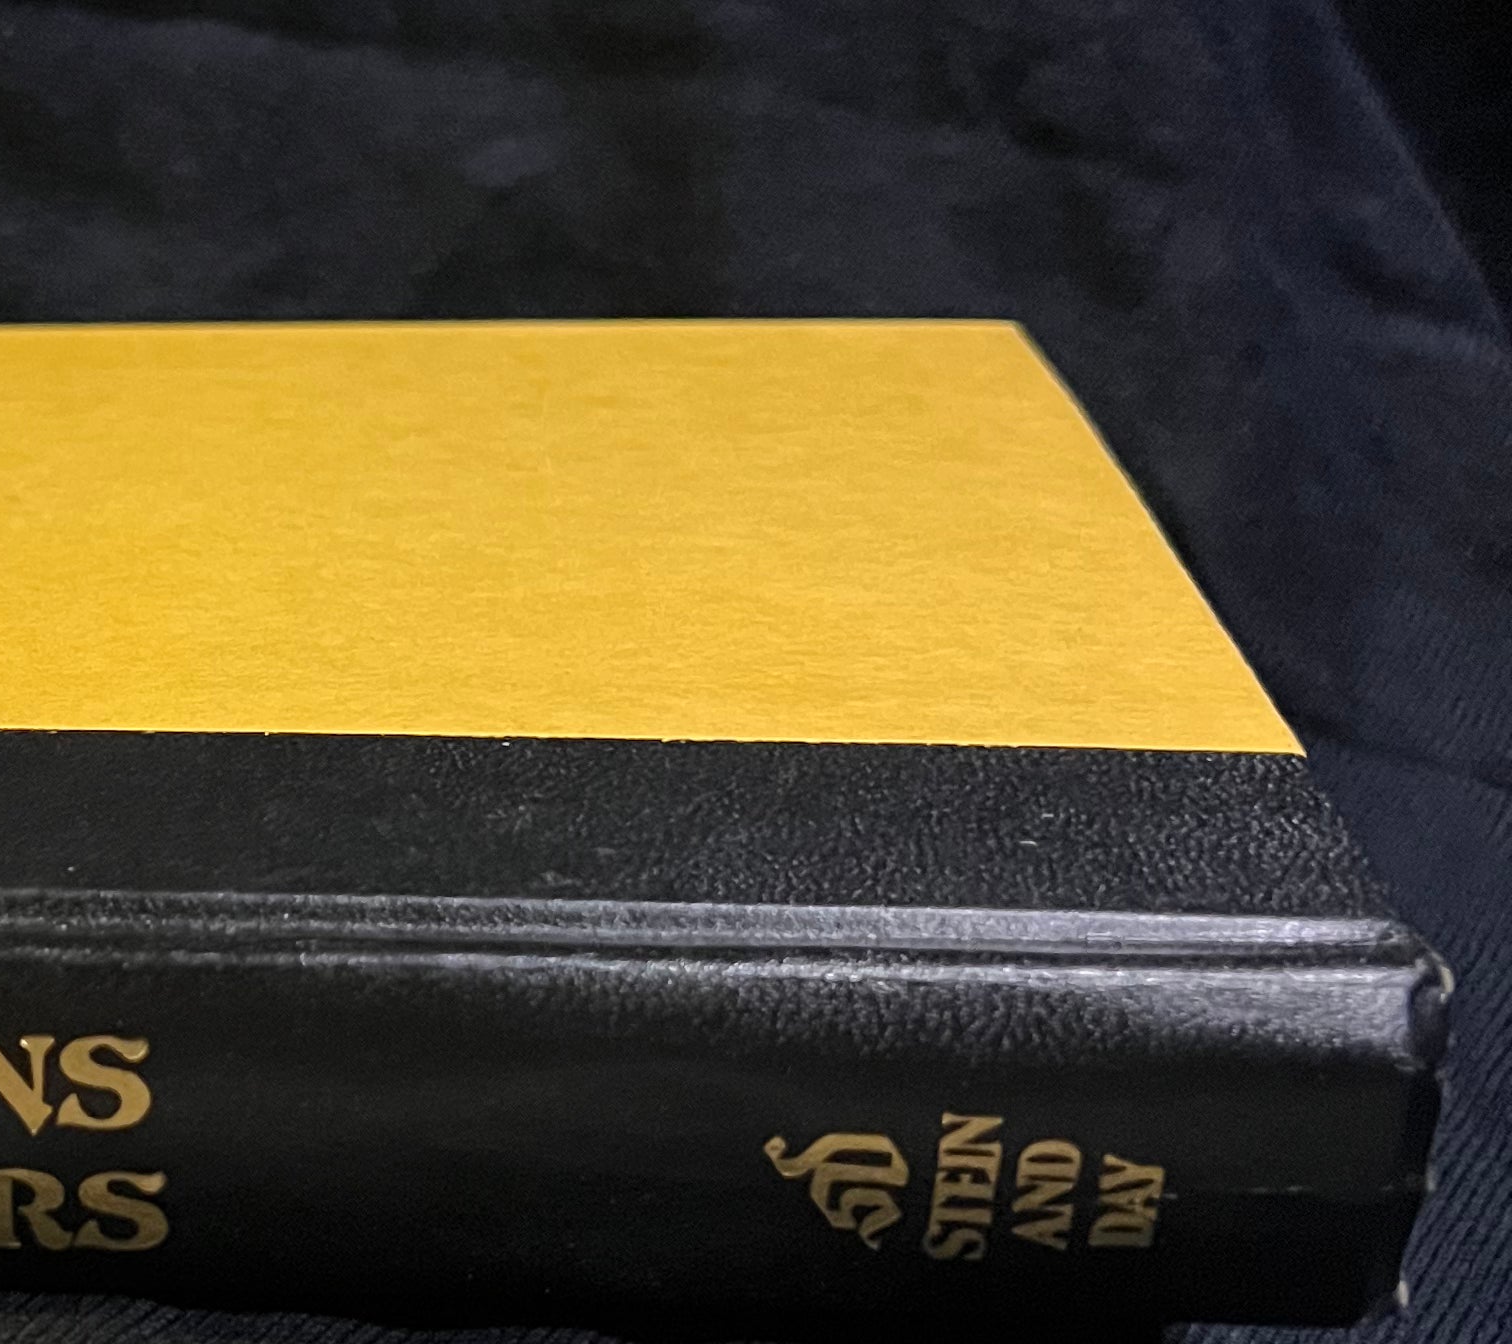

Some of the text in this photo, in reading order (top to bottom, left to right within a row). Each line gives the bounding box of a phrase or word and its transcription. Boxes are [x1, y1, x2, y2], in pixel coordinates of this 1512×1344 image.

[922, 1112, 1004, 1260] STEIN
[1012, 1138, 1082, 1250] AND
[1088, 1154, 1165, 1248] DAY
